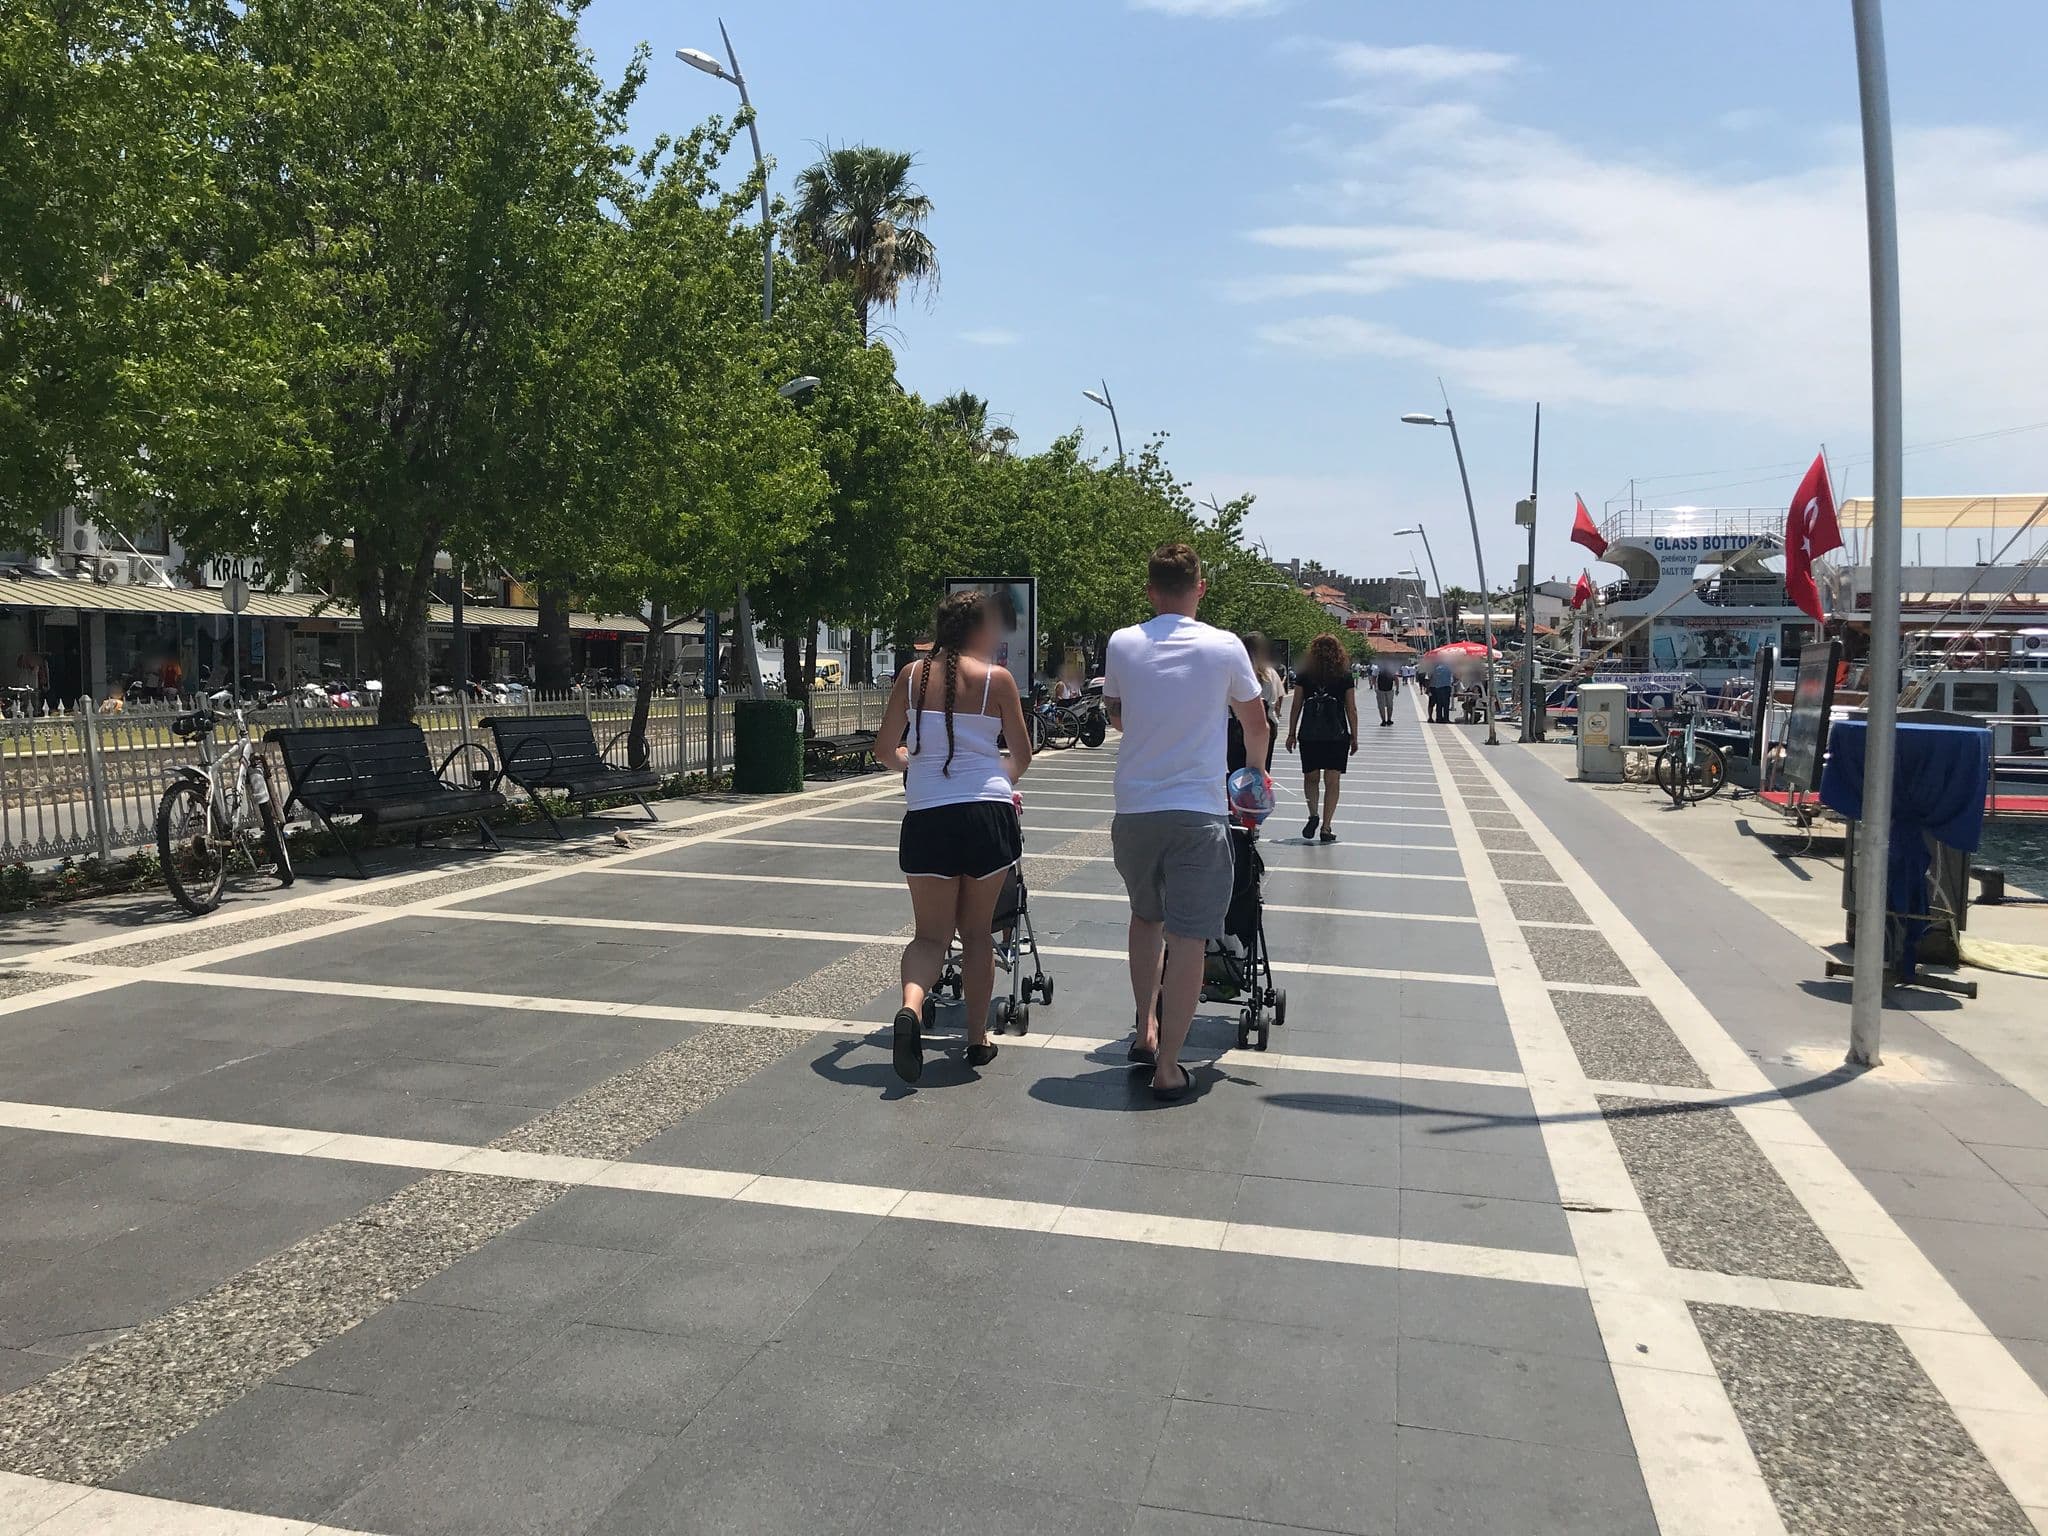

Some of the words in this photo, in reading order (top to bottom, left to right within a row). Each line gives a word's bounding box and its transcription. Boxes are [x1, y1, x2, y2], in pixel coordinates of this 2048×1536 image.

[1654, 536, 1697, 550] GLASS
[212, 558, 248, 582] KRAL
[1661, 567, 1679, 576] DAILY
